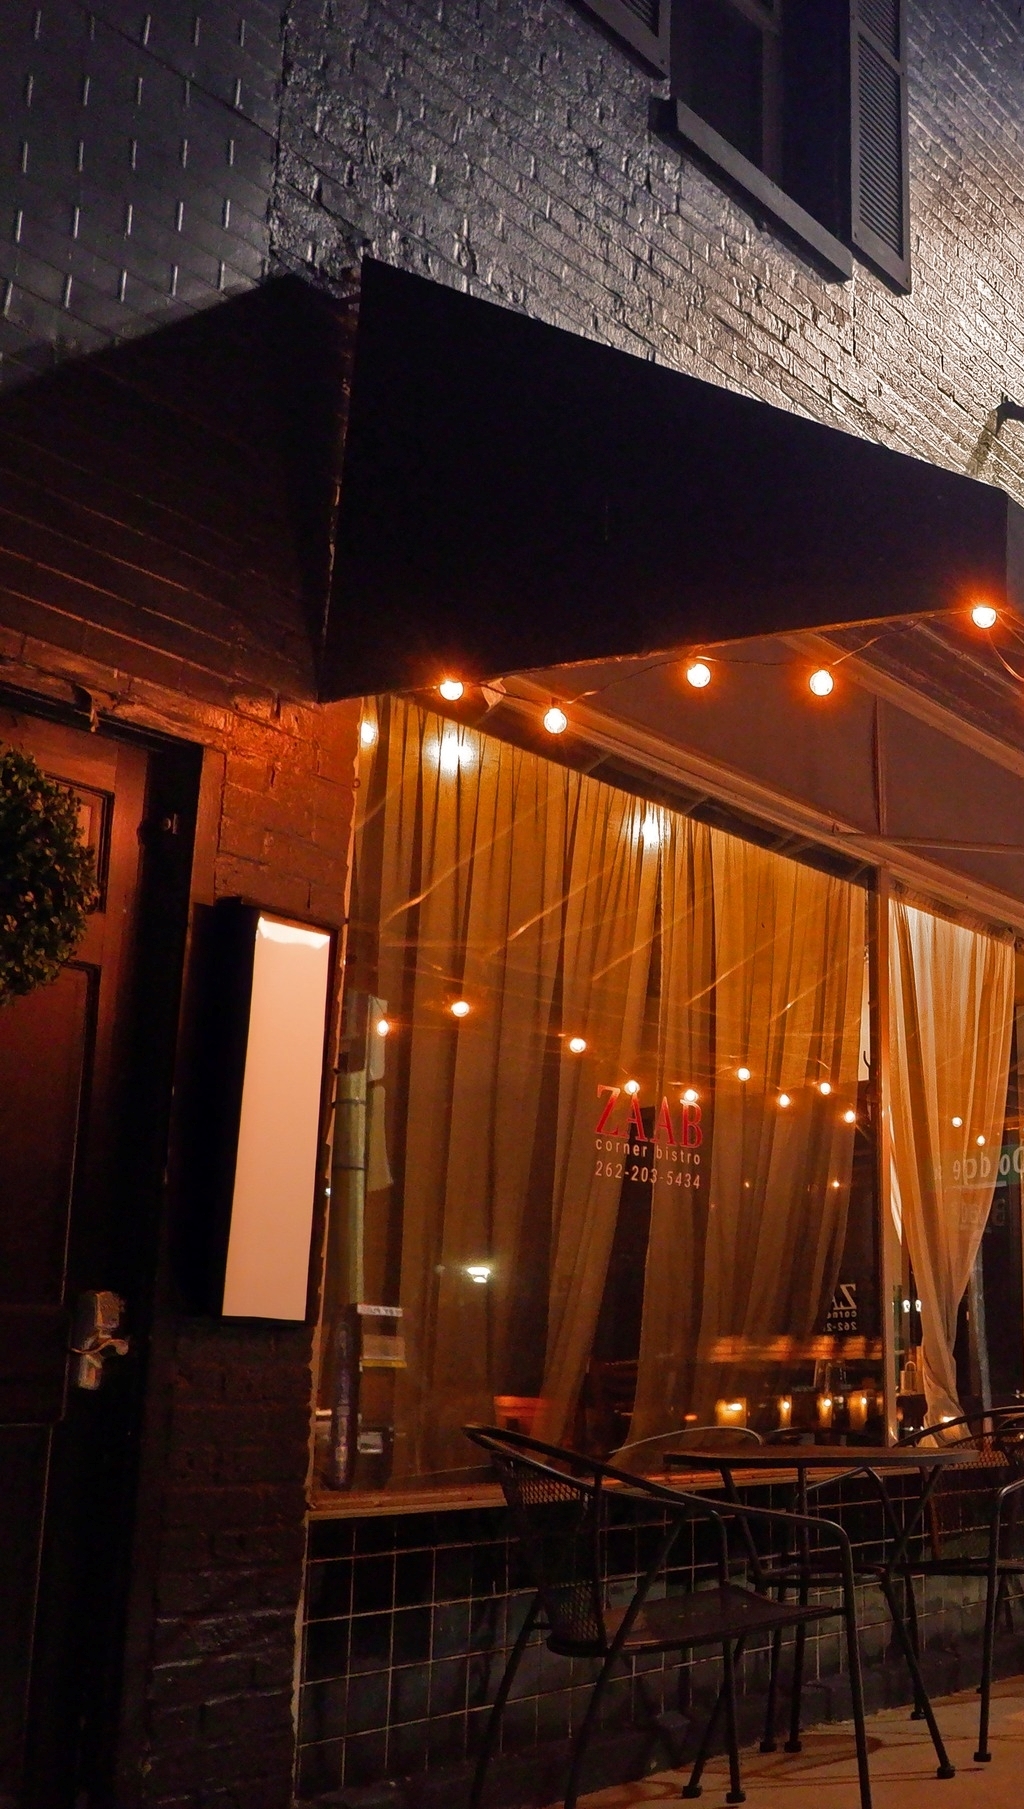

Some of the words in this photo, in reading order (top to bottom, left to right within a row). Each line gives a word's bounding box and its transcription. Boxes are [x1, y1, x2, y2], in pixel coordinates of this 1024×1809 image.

[594, 1084, 703, 1149] ZAAB
[595, 1138, 648, 1158] corner
[655, 1145, 701, 1165] bistro
[595, 1160, 700, 1190] 262-203-5434
